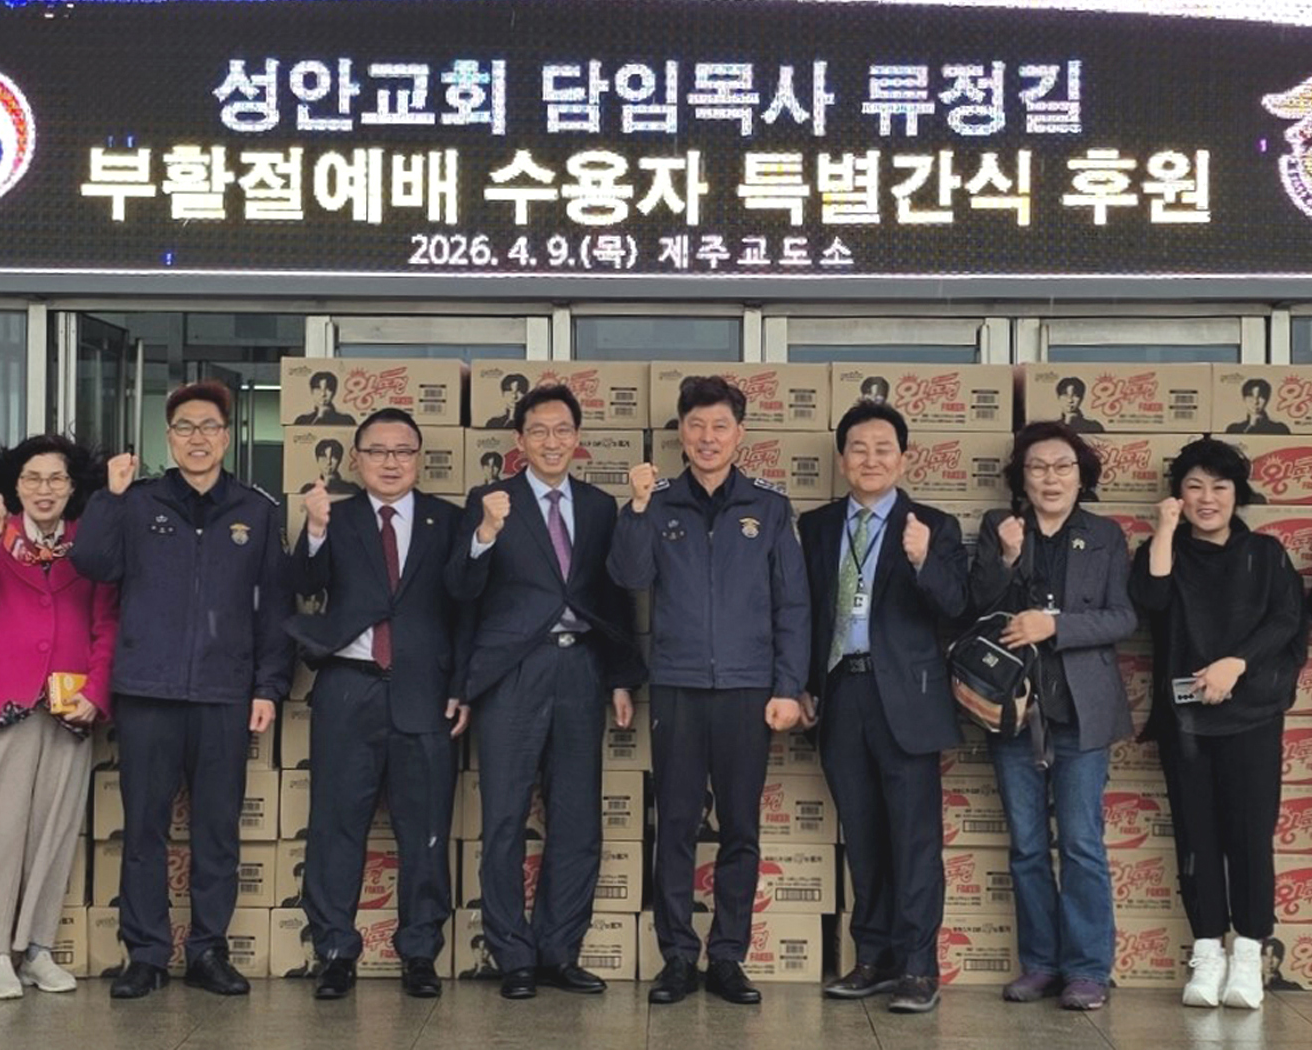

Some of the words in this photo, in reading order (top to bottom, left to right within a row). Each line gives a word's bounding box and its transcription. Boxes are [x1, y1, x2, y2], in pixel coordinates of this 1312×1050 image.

[213, 58, 506, 134] 성안교회
[543, 59, 835, 136] 담임목사
[862, 60, 1082, 136] 류정길
[81, 145, 459, 224] 부활절예배
[484, 148, 708, 226] 수용자
[737, 149, 1030, 226] 특별간식
[1061, 149, 1210, 225] 후원
[409, 234, 498, 265] 2026.
[508, 235, 536, 266] 4.
[548, 234, 638, 268] 9.(목)
